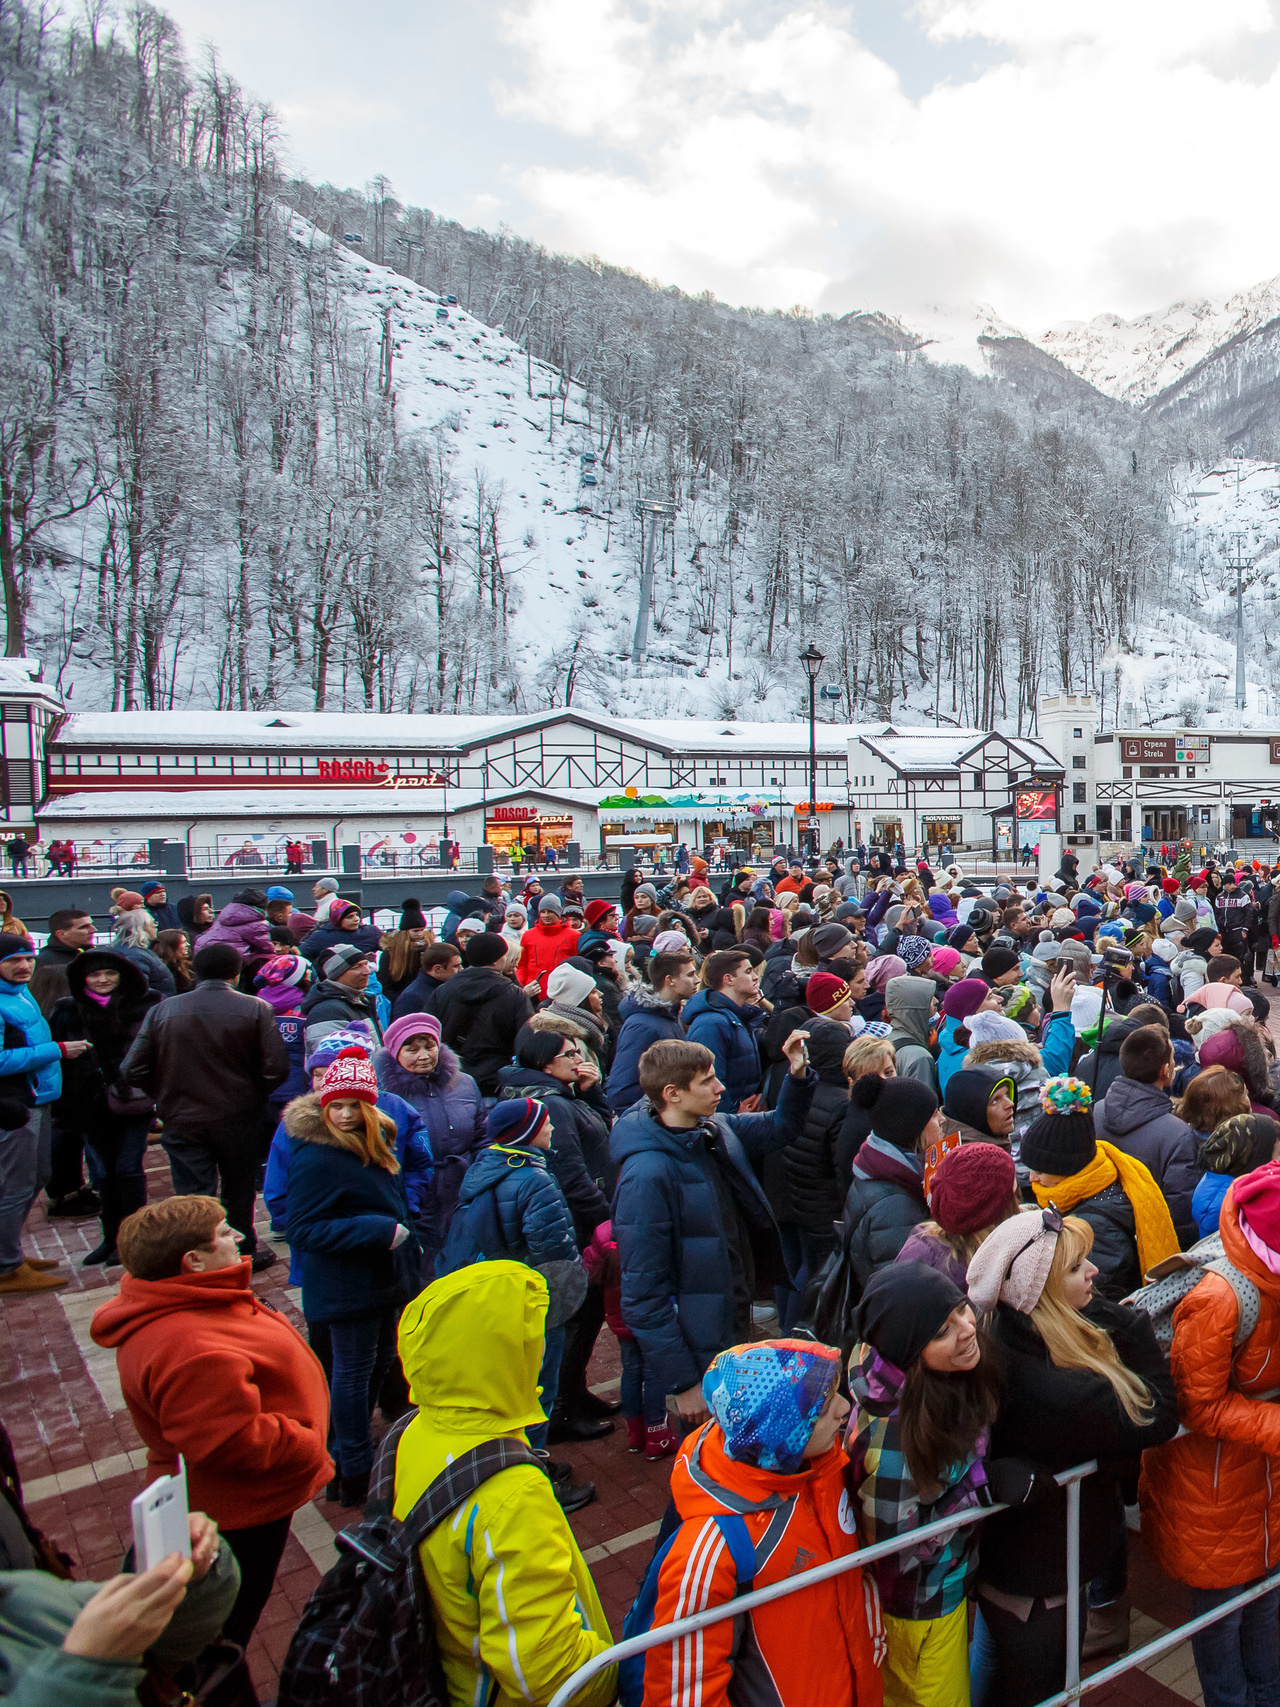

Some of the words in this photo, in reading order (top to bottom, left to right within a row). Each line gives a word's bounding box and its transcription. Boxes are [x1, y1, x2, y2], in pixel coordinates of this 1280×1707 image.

[1144, 740, 1167, 749] Стрела
[1144, 750, 1164, 758] Strela
[319, 760, 374, 780] BOSCO
[715, 805, 748, 813] СУВЕНИРЫ
[800, 802, 835, 810] КНТ
[494, 807, 528, 820] BOSCO
